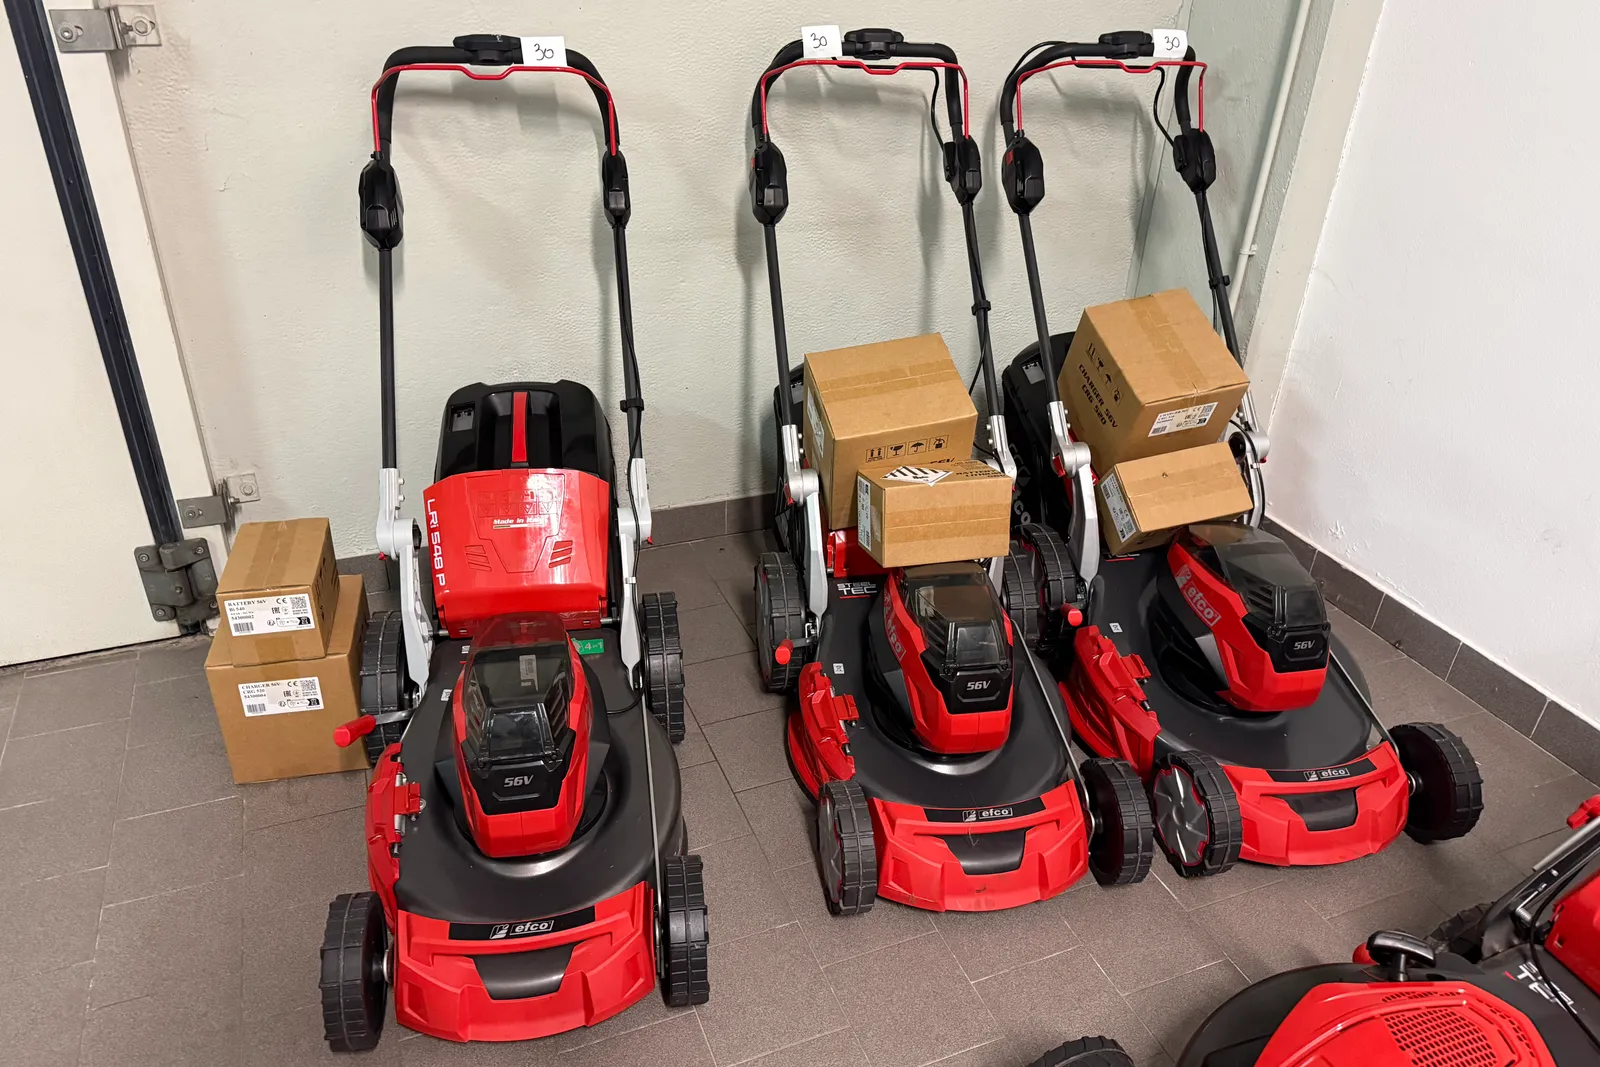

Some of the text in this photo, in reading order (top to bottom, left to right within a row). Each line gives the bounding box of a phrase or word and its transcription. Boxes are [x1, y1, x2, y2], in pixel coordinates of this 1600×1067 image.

[810, 32, 828, 49] 30
[1164, 36, 1180, 51] 30
[533, 43, 555, 61] 30
[1078, 363, 1118, 428] CHARGER 56V
[1081, 384, 1107, 426] CRG 520
[427, 498, 446, 587] LRi 548 P
[837, 586, 878, 595] TEC
[1186, 585, 1215, 620] efco
[1293, 640, 1316, 650] 56V
[966, 680, 992, 691] 56V
[1321, 768, 1346, 777] efco
[503, 775, 534, 788] 56V
[981, 808, 1010, 817] efco
[514, 921, 549, 933] efco
